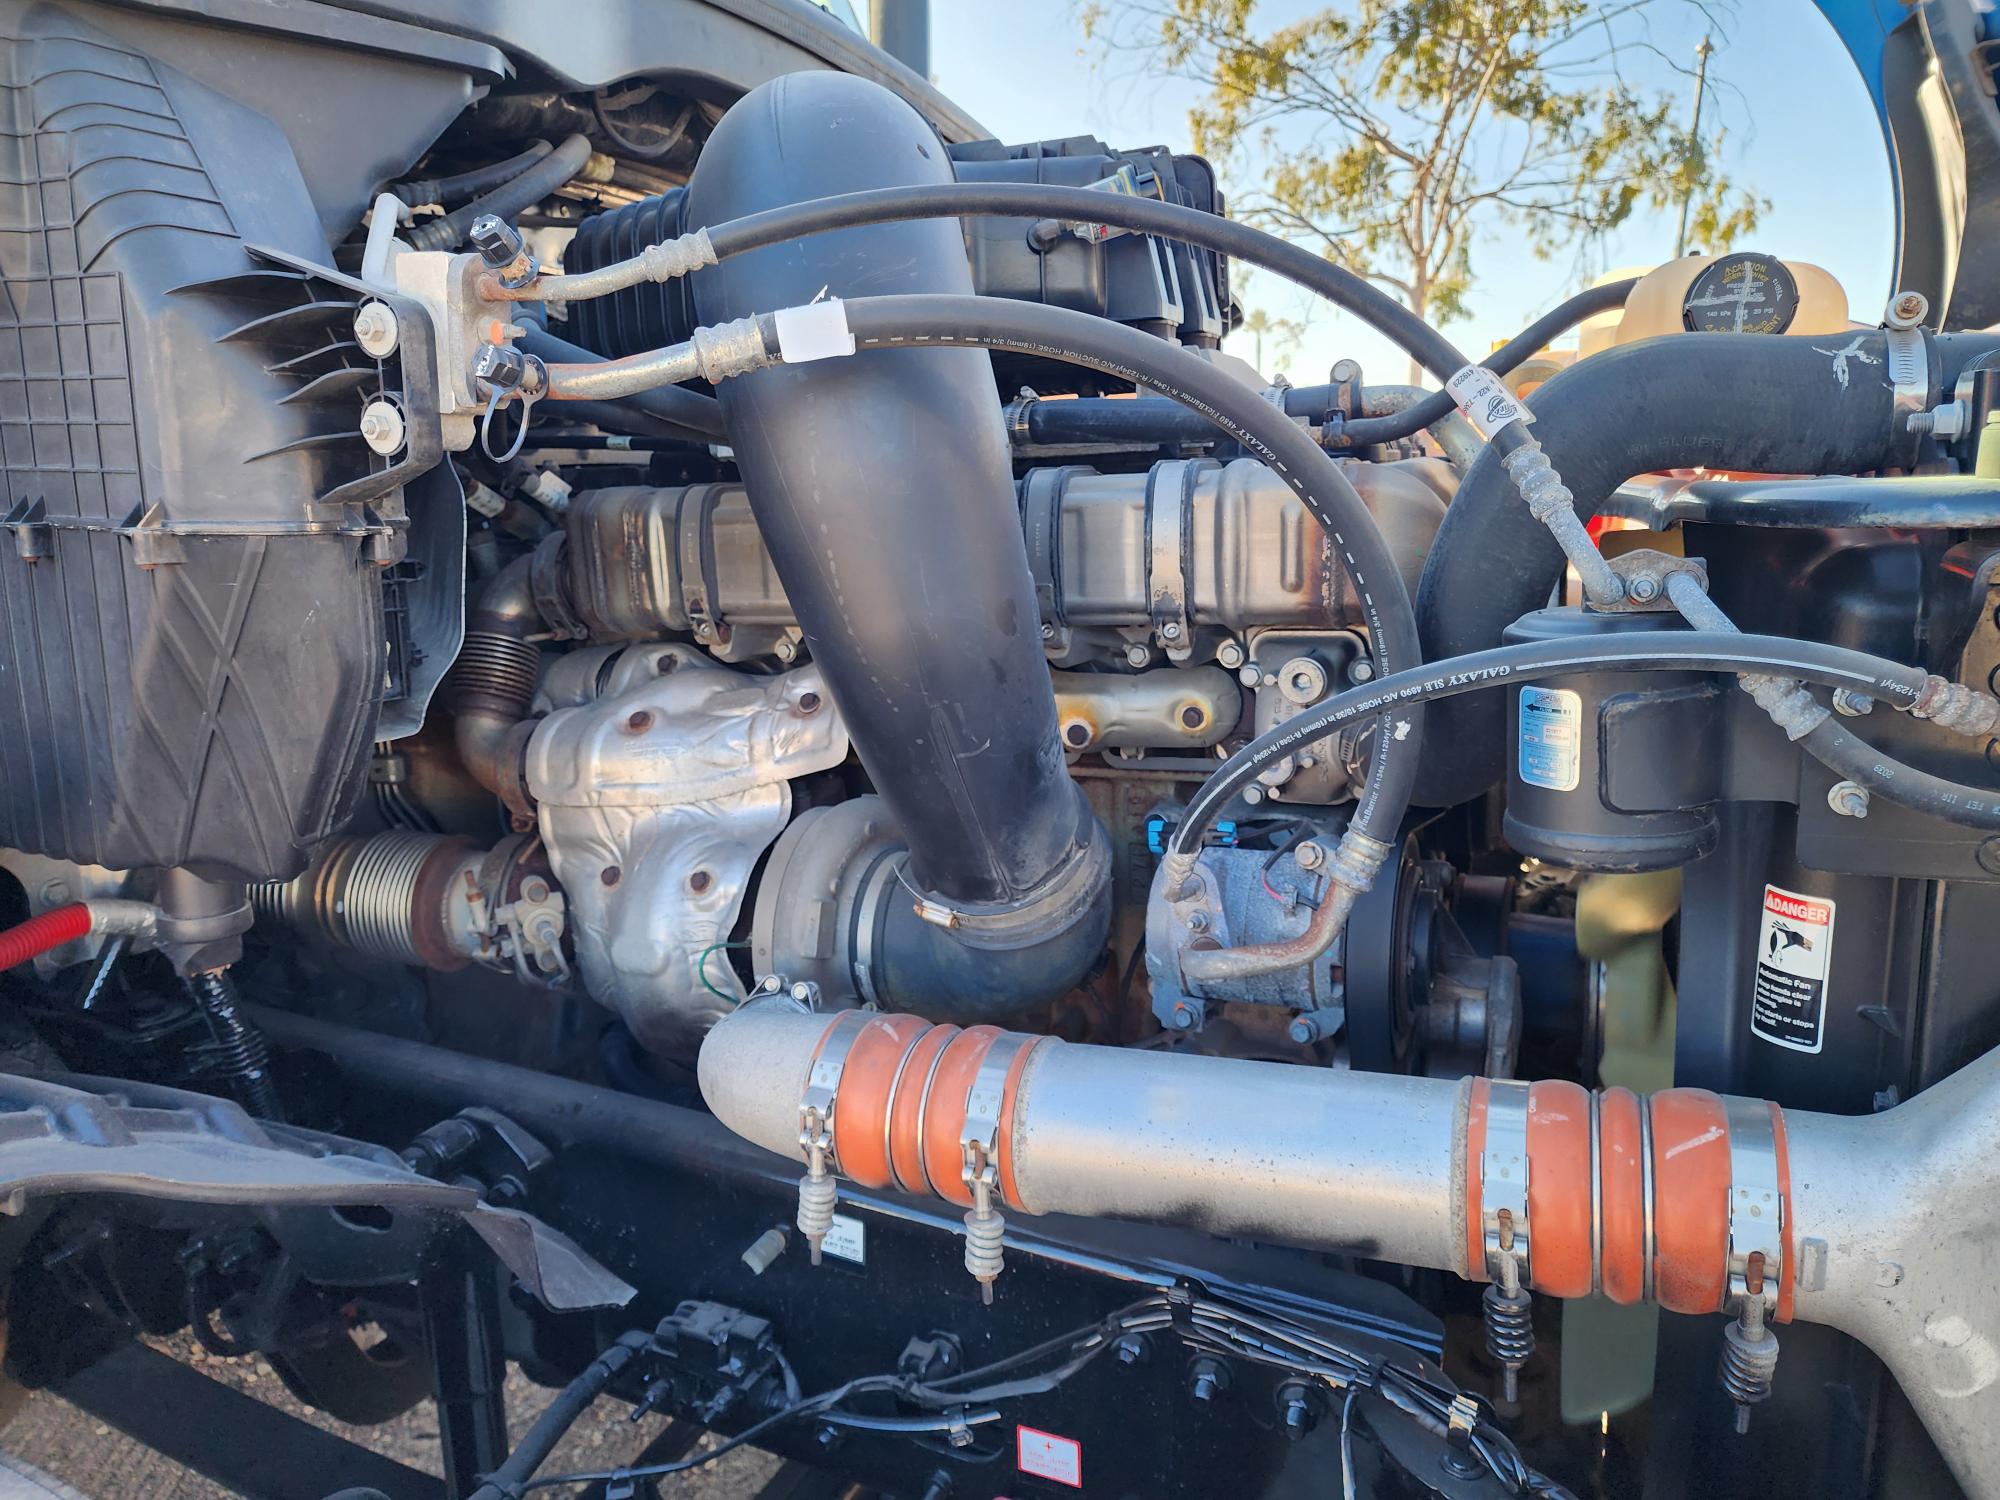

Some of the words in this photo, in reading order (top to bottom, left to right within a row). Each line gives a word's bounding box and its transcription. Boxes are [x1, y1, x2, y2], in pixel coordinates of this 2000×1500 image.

[1006, 338, 1036, 350] (19mm)
[1038, 344, 1061, 355] HOSE
[1063, 350, 1099, 364] SUCTION
[1101, 360, 1115, 369] A/C
[1115, 363, 1149, 382] R-1234yf
[1153, 379, 1178, 395] R-134a
[1180, 392, 1220, 418] FlexBarrier
[1219, 415, 1237, 430] 4880
[1236, 428, 1276, 460] GALAXY
[1376, 629, 1388, 655] (19mm)
[1447, 665, 1511, 686] GALAXY
[1400, 685, 1422, 697] 4890
[1424, 678, 1445, 692] SLE
[1356, 697, 1382, 711] HOSE
[1382, 692, 1398, 702] A/C
[1327, 714, 1335, 722] in
[1335, 706, 1357, 719] 13/32
[1300, 717, 1327, 735] (10mm)
[1279, 730, 1301, 746] R-134a
[1775, 899, 1827, 922] DANGER
[1760, 967, 1793, 986] Automatic
[1794, 980, 1811, 990] Fan
[1770, 985, 1791, 996] hands
[1791, 992, 1812, 1000] clear
[1770, 994, 1793, 1005] engine
[1764, 1010, 1782, 1020] starts
[1792, 1019, 1814, 1028] stops
